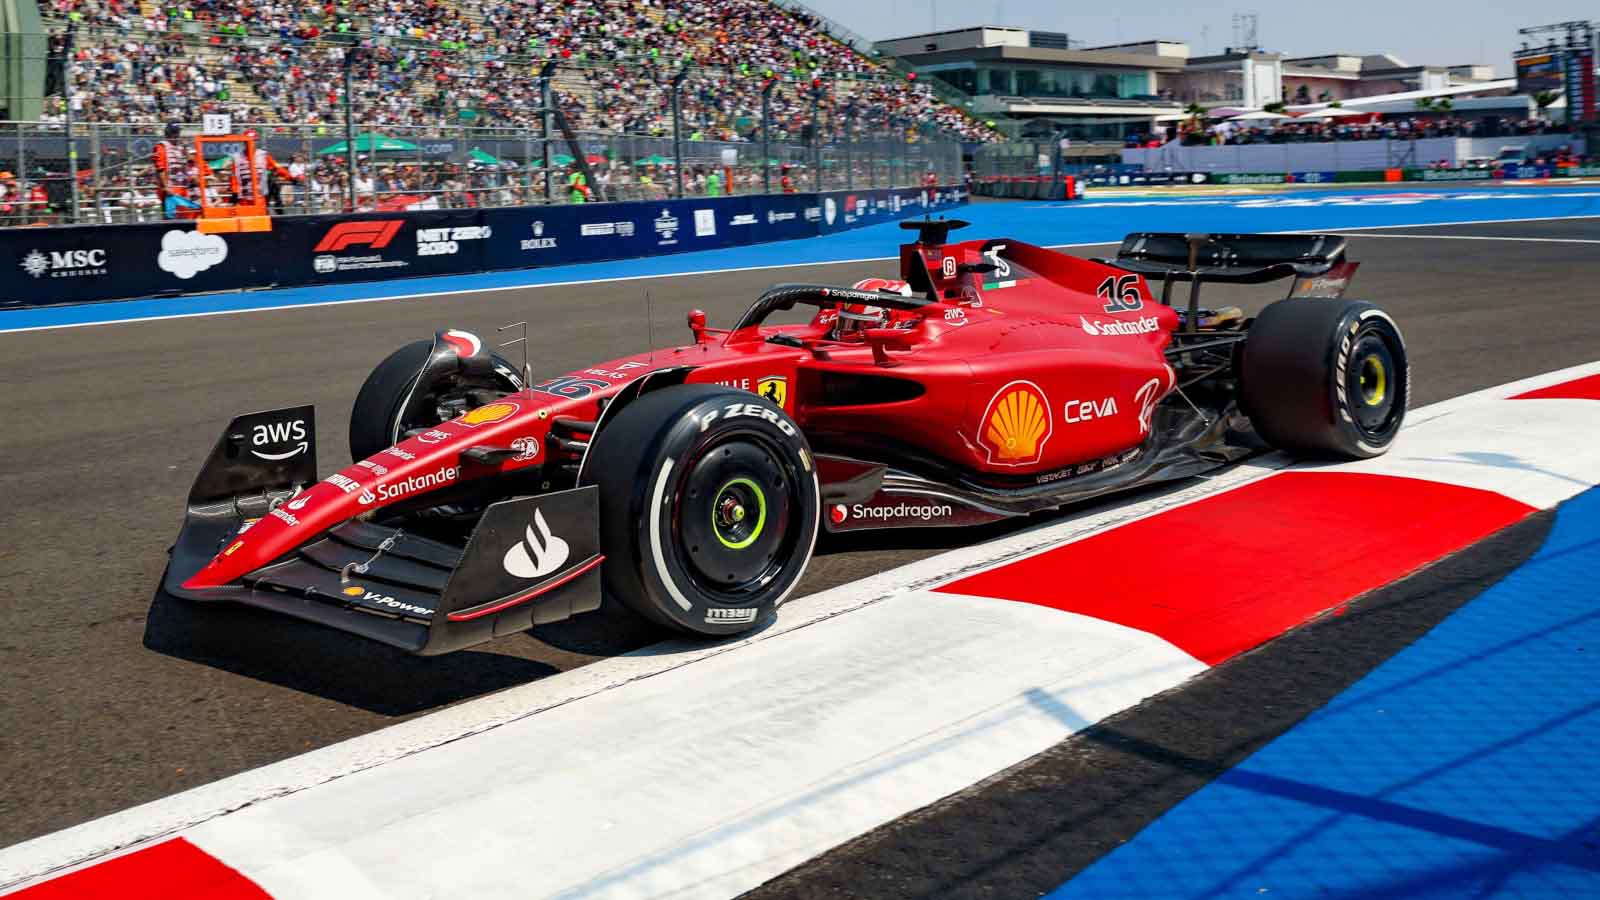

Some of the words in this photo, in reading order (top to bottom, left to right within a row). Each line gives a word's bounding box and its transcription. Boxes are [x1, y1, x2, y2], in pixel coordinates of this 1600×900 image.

[520, 238, 557, 250] ROLEX
[51, 249, 106, 269] MSC
[832, 289, 880, 301] Snapdragon
[1097, 273, 1144, 314] 16
[944, 308, 966, 320] aws
[1094, 316, 1160, 336] Santander
[531, 376, 611, 401] 16
[701, 409, 719, 432] P
[723, 403, 797, 437] ZERO
[252, 419, 306, 446] aws
[376, 465, 463, 501] Santander
[852, 502, 952, 521] Snapdragon
[363, 591, 435, 615] V-Power
